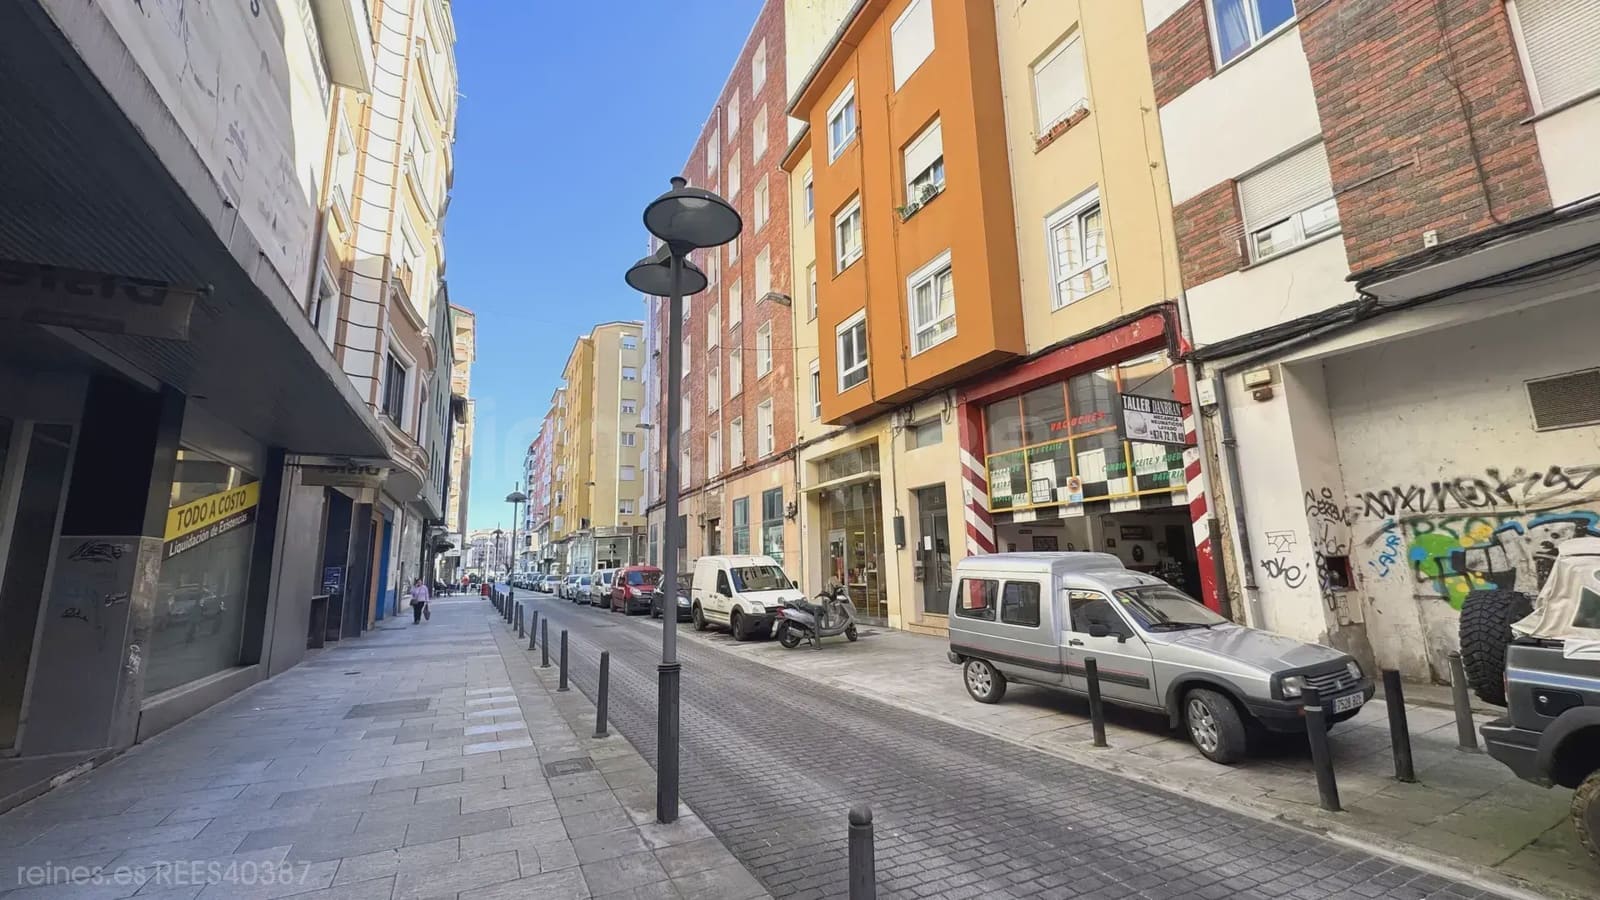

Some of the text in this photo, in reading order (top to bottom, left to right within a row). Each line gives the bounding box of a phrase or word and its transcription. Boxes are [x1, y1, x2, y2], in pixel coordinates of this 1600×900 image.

[1122, 395, 1151, 412] TALLER
[177, 490, 246, 531] TODO A COSTO
[169, 513, 247, 556] Liquidación de Existencias
